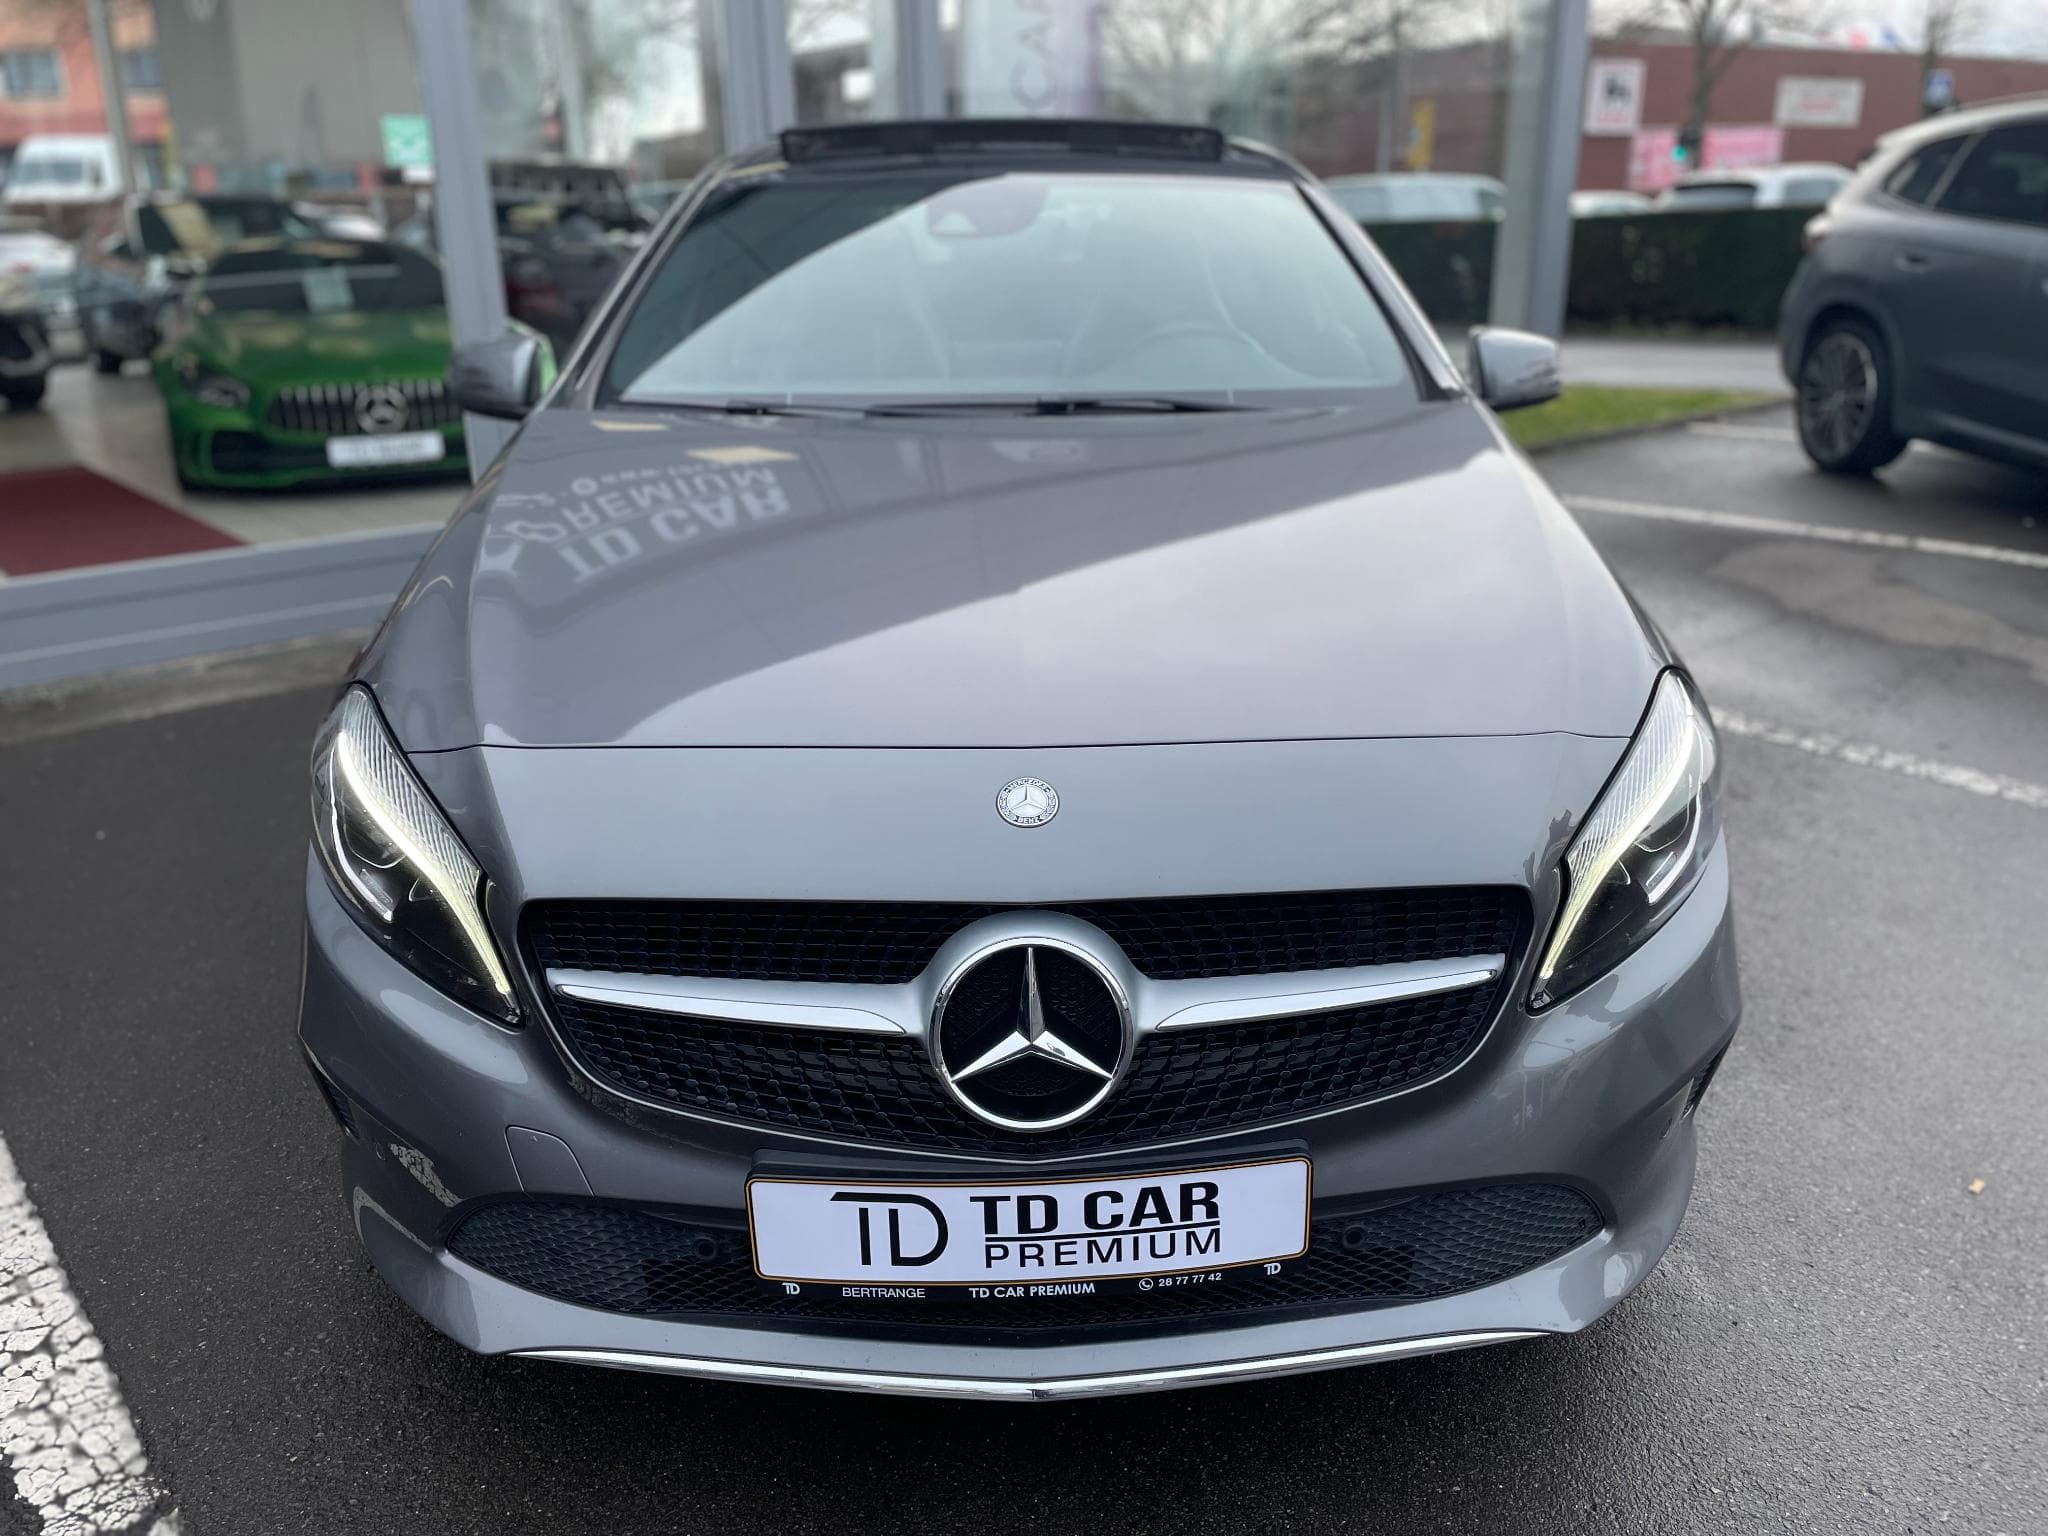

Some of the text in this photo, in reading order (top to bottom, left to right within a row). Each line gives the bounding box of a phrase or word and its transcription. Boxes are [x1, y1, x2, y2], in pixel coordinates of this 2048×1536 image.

[1009, 0, 1057, 110] CA
[969, 1181, 1220, 1235] TD CAR
[985, 1227, 1221, 1269] PREMIUM
[842, 1287, 926, 1298] BERTRANGE
[969, 1283, 1096, 1299] TD CAR PREMIUM
[1158, 1272, 1222, 1288] 28 77 77 42
